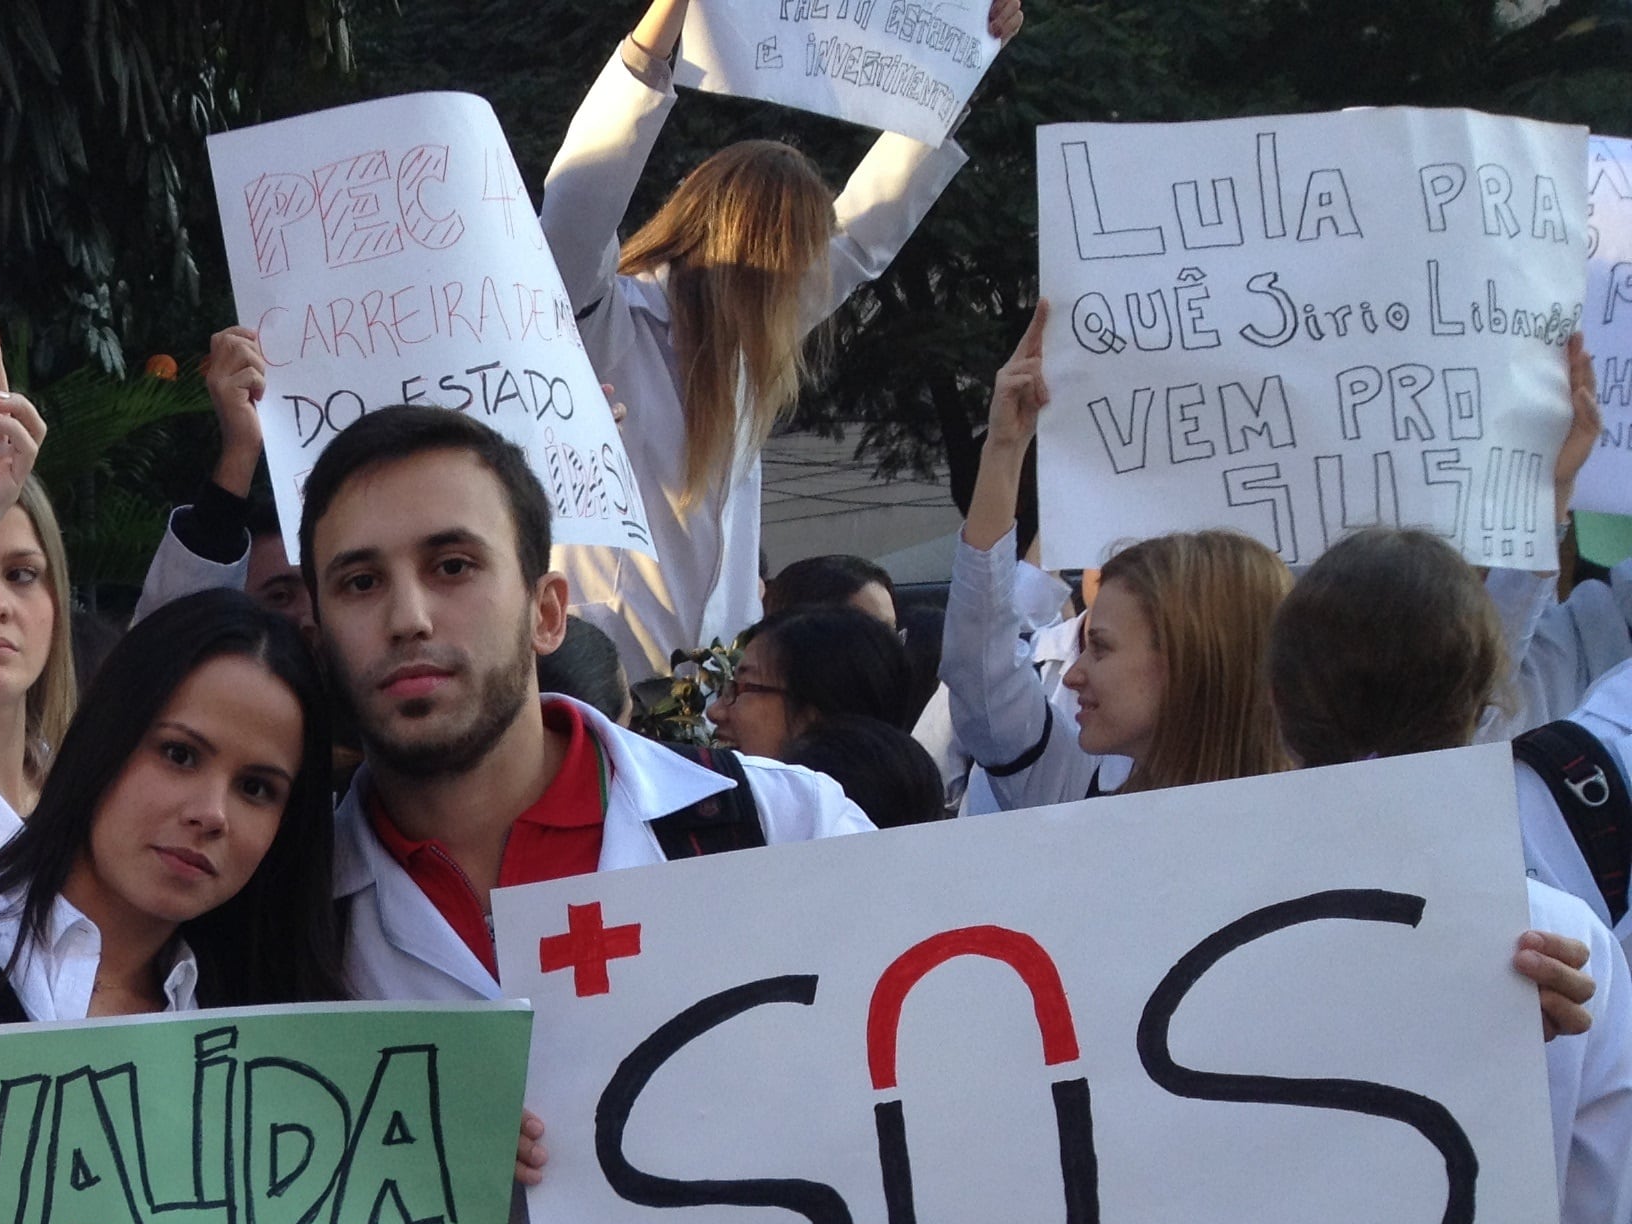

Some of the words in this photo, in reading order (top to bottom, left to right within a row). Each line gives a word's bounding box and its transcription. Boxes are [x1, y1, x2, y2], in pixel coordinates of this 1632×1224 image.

[755, 35, 784, 70] E
[243, 143, 466, 280] PEC
[1419, 162, 1570, 245] PRA
[256, 276, 512, 368] CARREIRA
[512, 282, 552, 342] DE
[1071, 266, 1222, 356] QUÊ
[282, 389, 366, 449] DO
[401, 360, 574, 422] ESTADO
[1087, 374, 1298, 475] VEM
[1335, 362, 1483, 444] PRO
